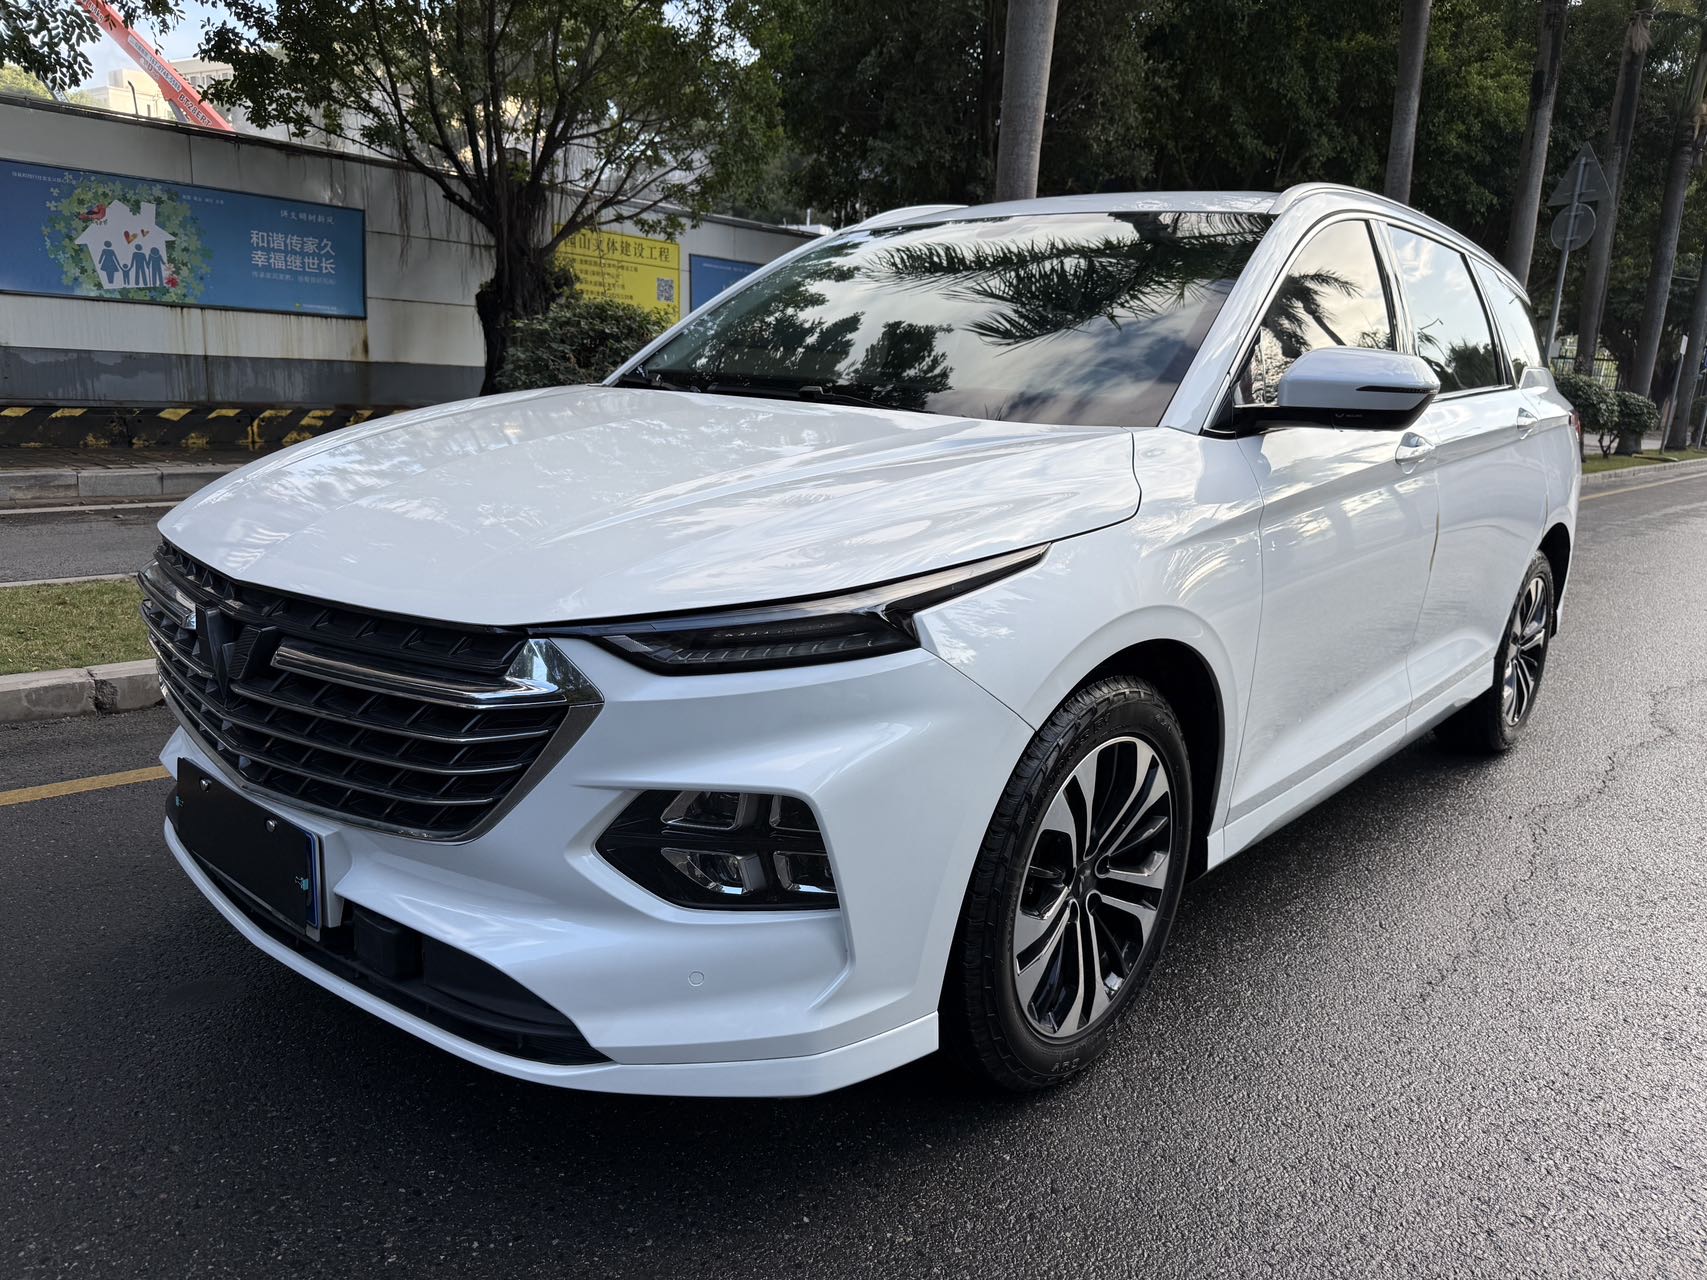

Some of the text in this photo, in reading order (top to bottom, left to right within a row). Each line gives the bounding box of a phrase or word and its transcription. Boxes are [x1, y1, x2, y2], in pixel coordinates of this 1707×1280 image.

[178, 93, 212, 127] BT28ERT
[250, 230, 336, 256] 和谐传家久
[251, 250, 336, 274] 幸福继世长
